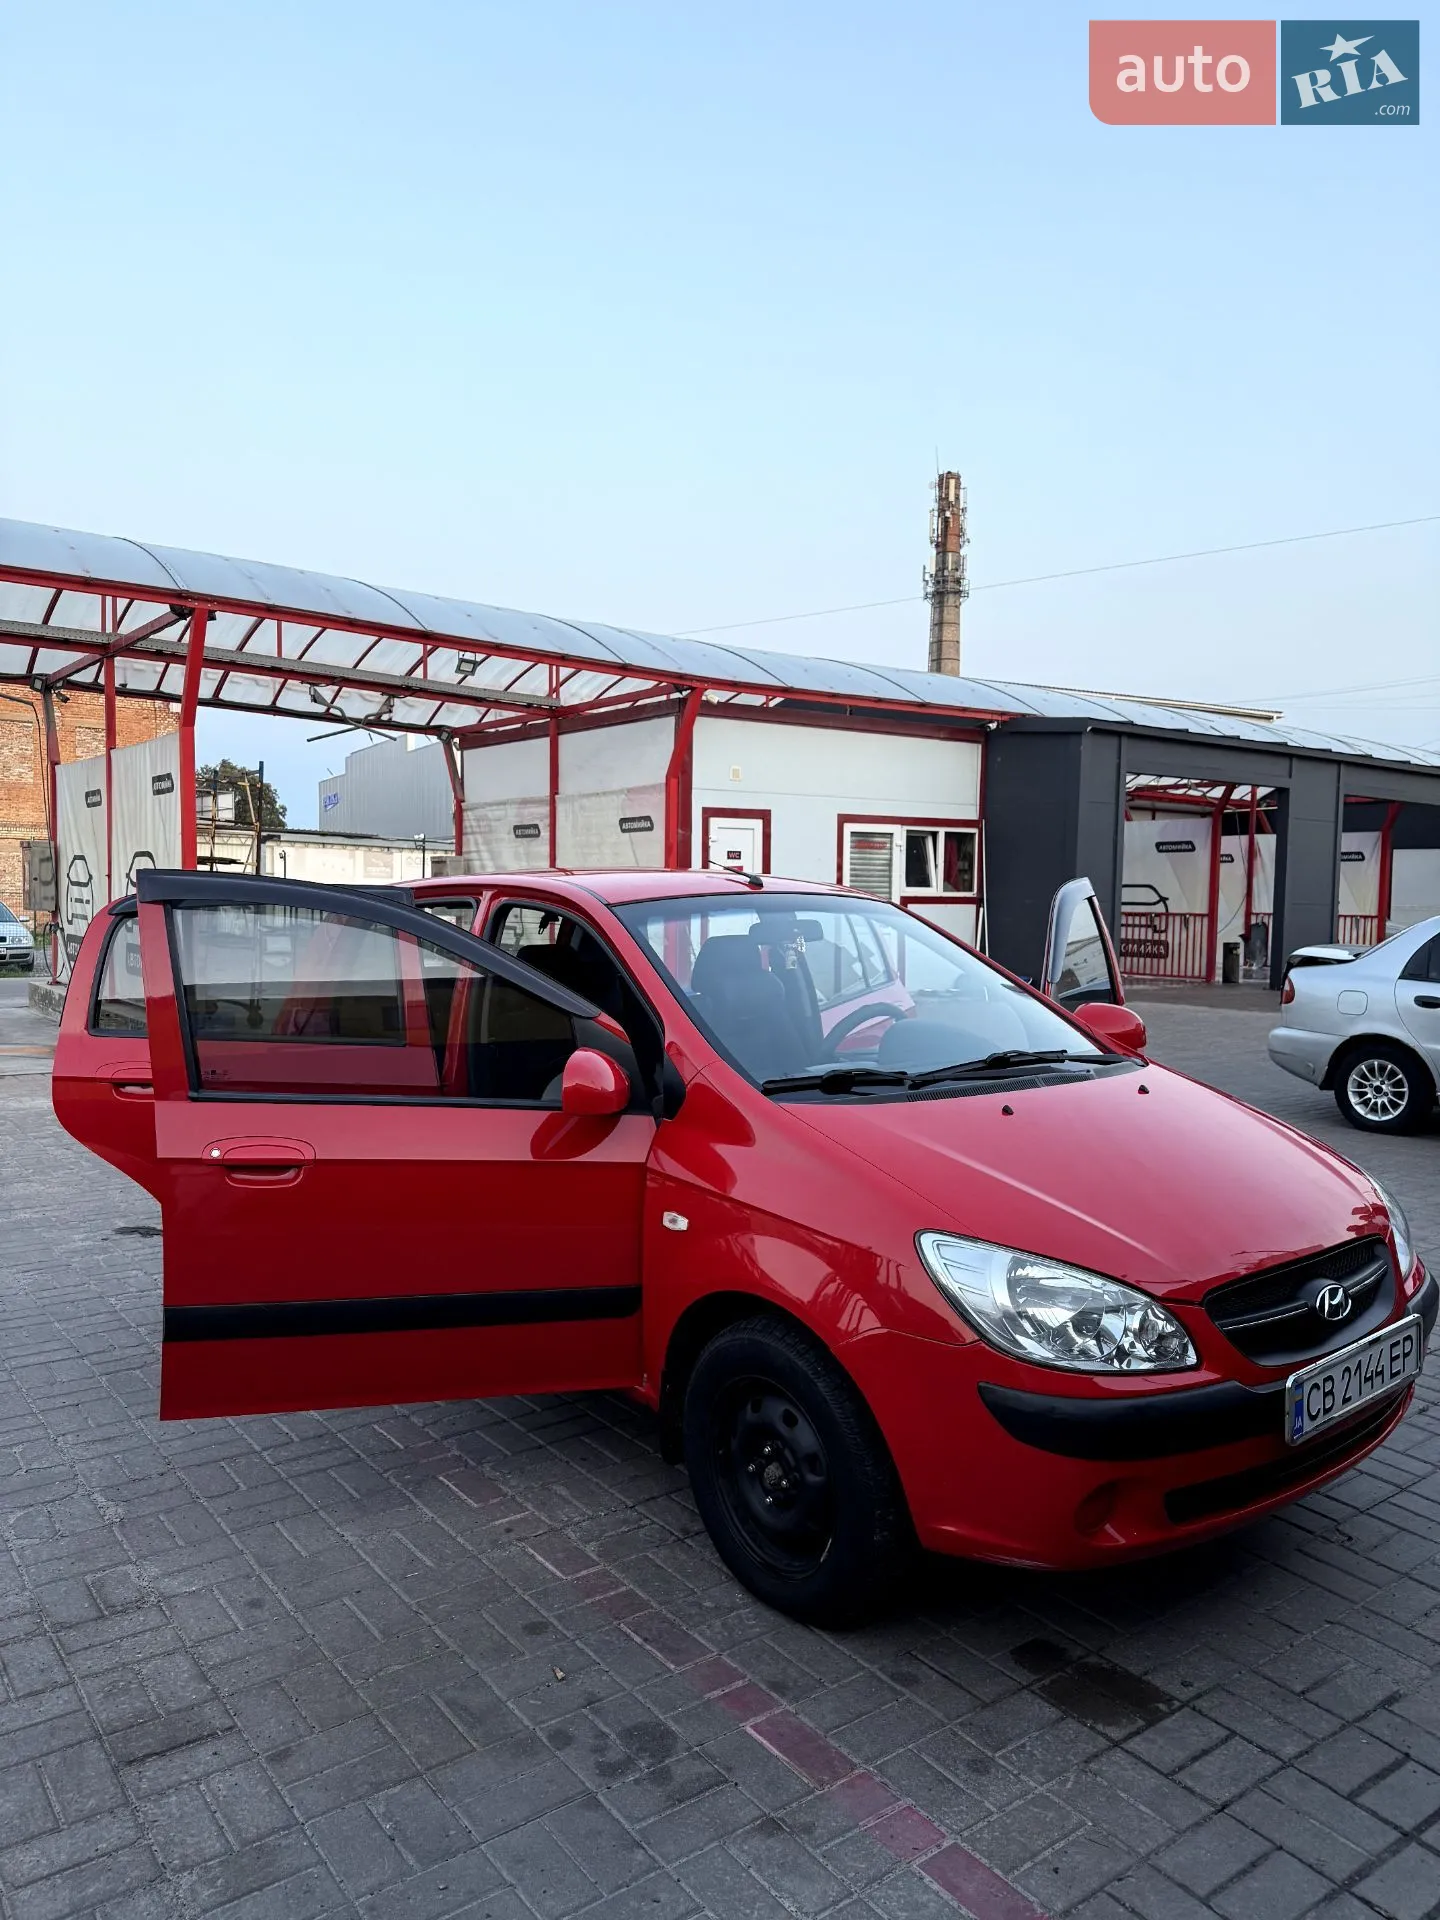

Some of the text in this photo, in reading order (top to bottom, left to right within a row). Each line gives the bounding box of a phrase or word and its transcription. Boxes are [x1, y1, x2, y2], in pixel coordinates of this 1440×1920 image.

[621, 819, 650, 830] АВТОМИЙКА
[1307, 1334, 1414, 1421] CB 2144 EP
